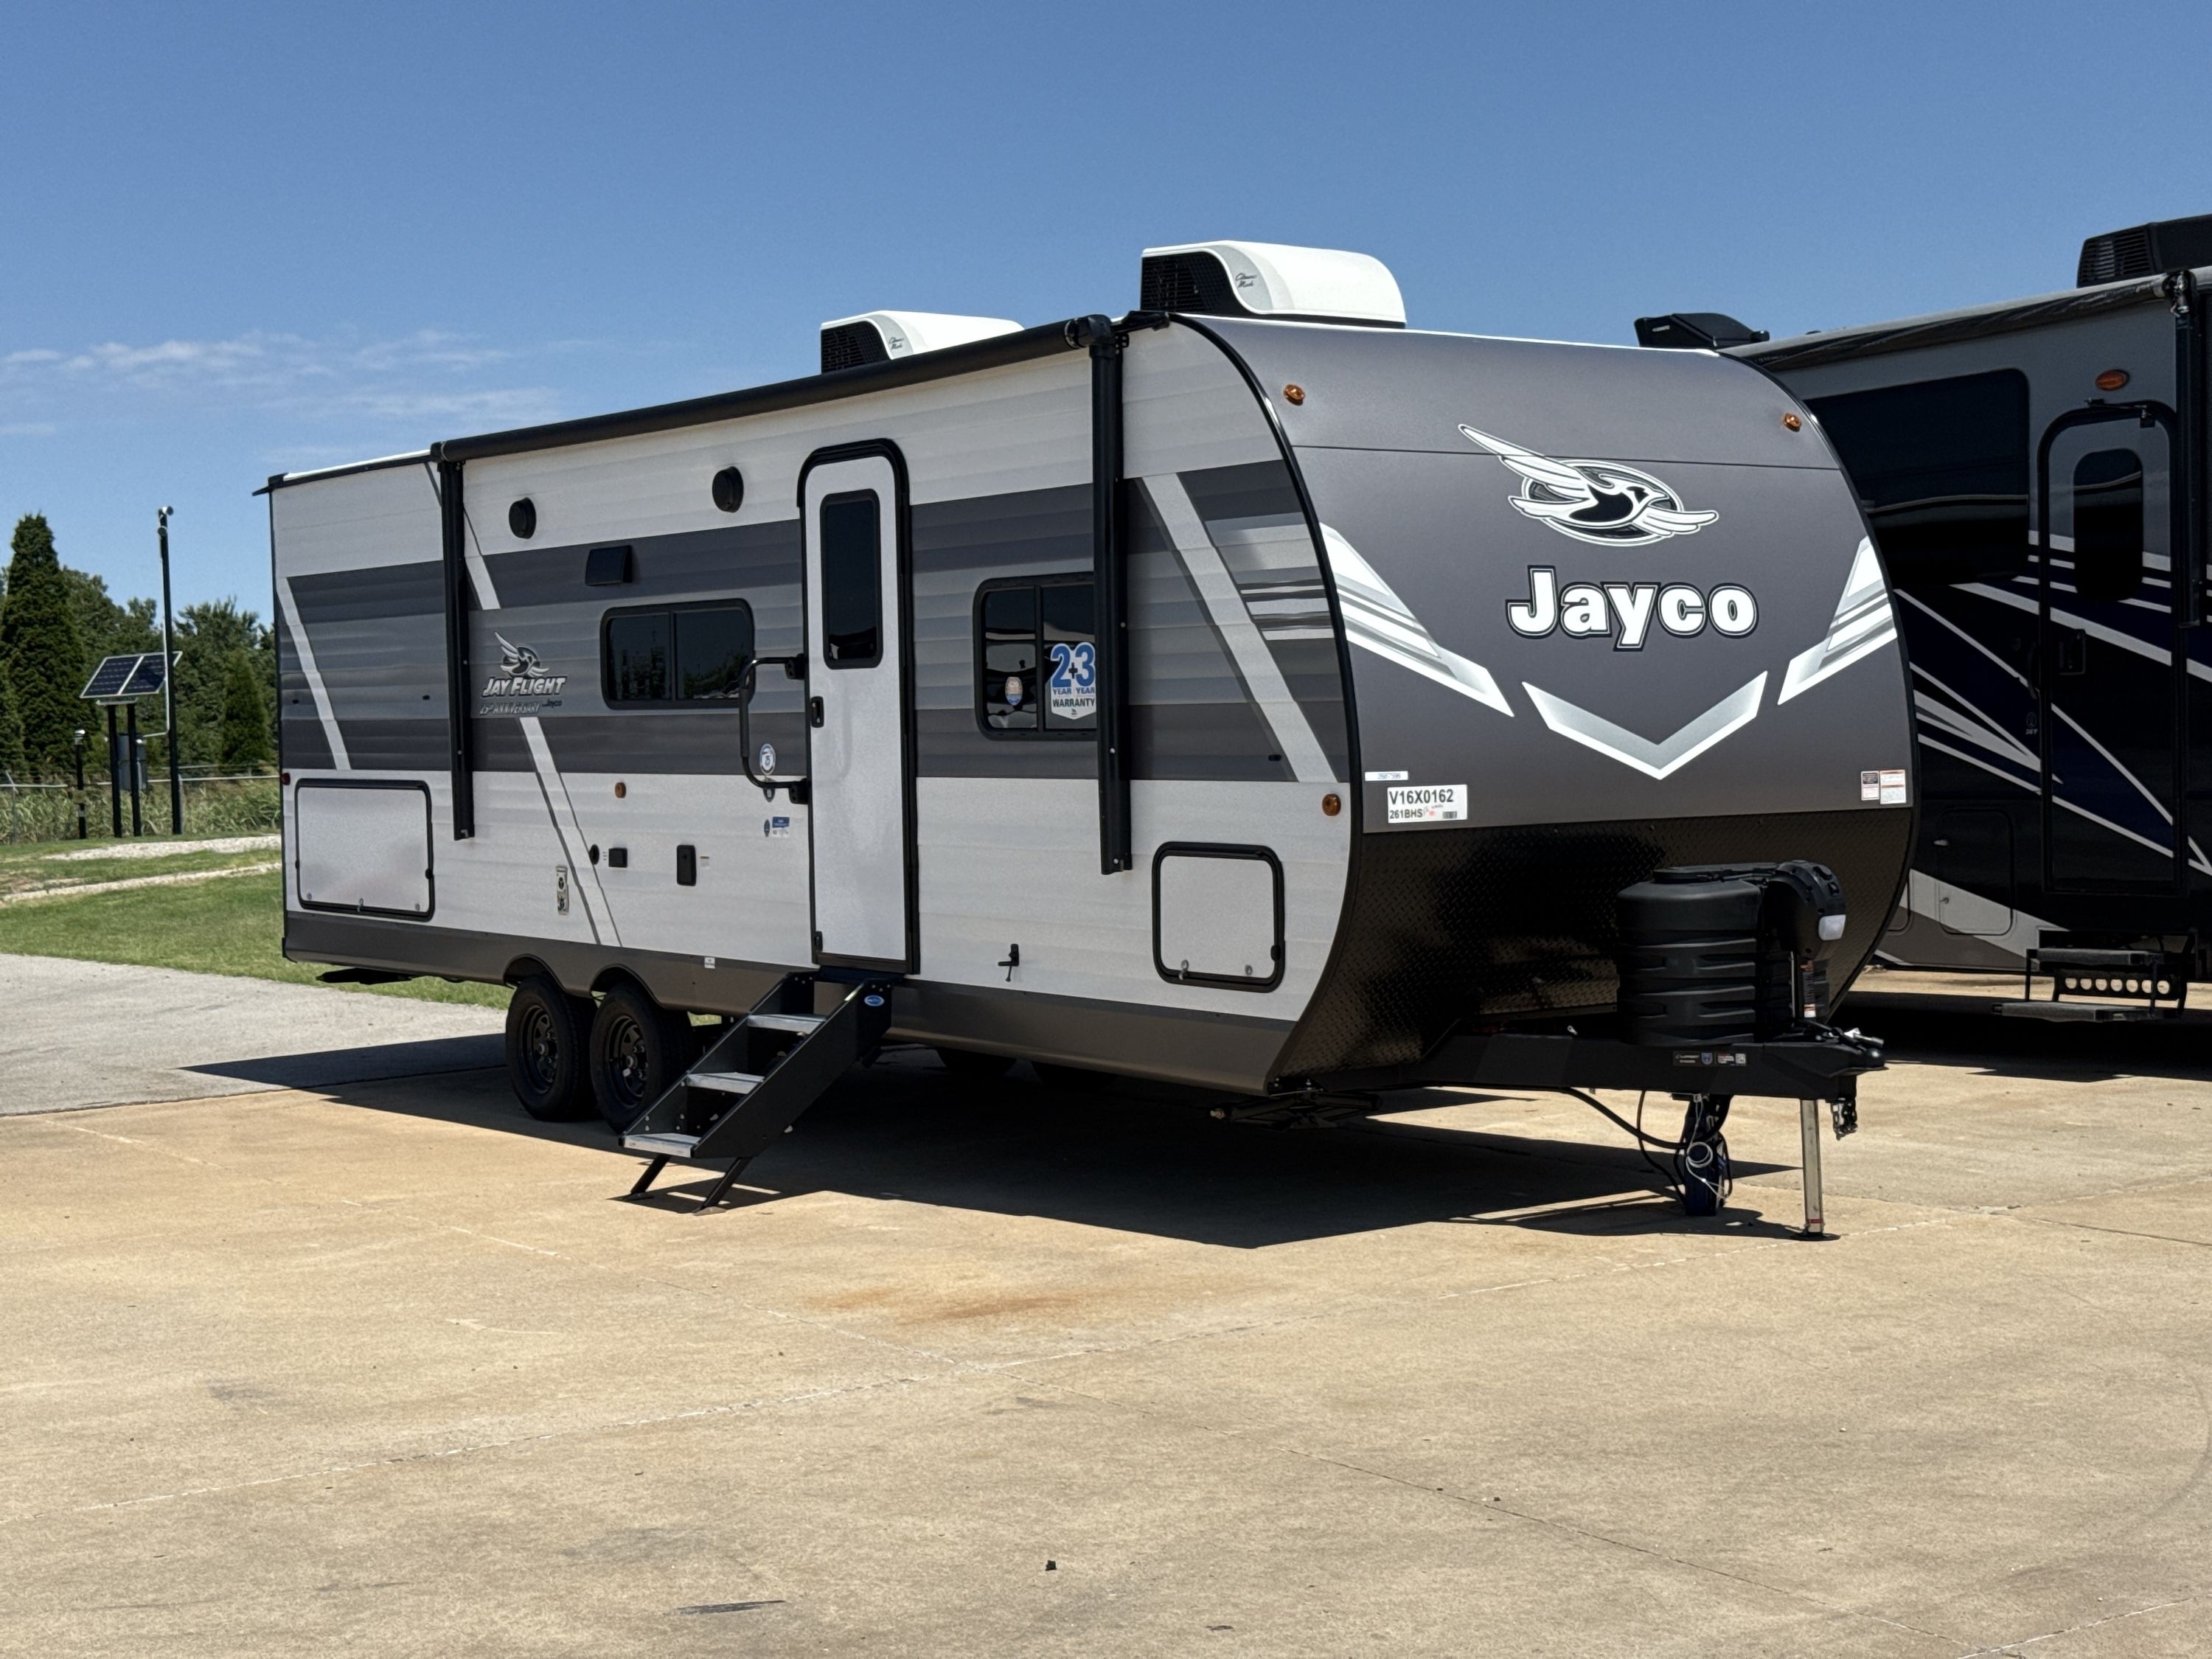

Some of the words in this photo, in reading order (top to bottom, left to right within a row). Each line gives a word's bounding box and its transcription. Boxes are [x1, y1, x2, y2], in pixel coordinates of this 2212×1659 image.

[1506, 566, 1759, 651] Jayco
[482, 677, 511, 698] JAY
[509, 676, 567, 696] FLIGHT
[1052, 698, 1095, 707] WARRANTY
[1389, 789, 1454, 804] V16X0162
[1389, 809, 1423, 819] 261BHS
